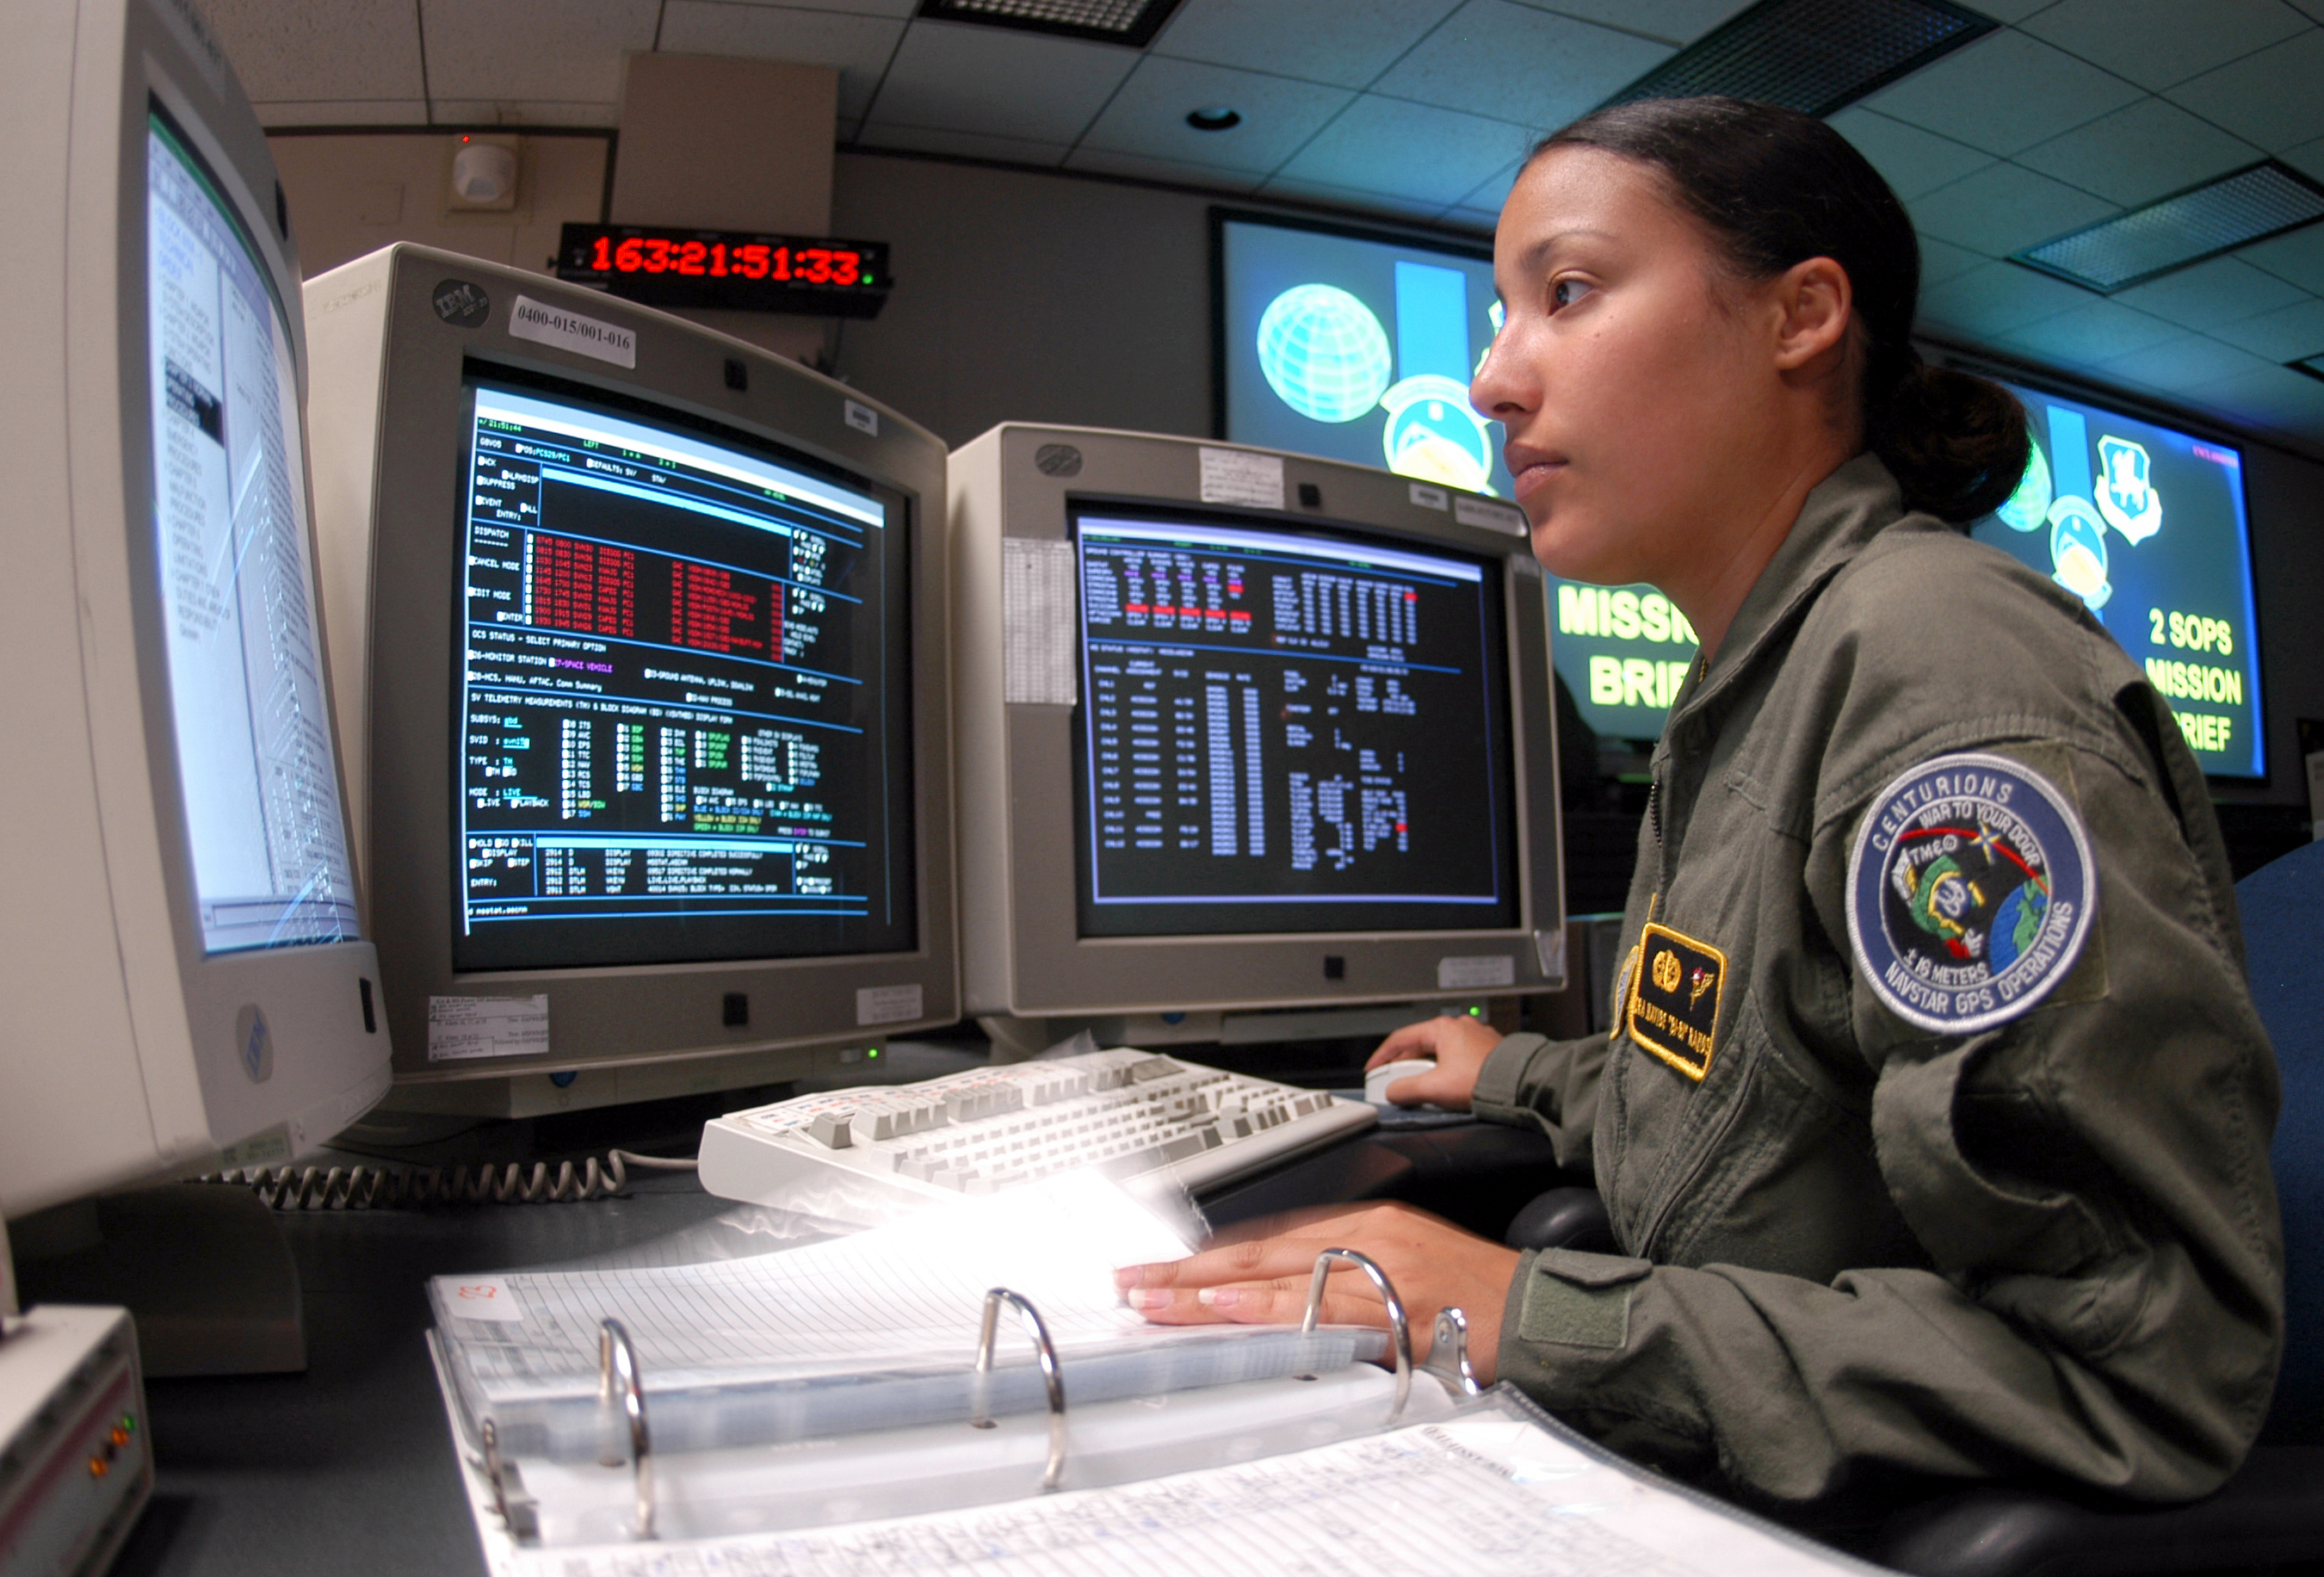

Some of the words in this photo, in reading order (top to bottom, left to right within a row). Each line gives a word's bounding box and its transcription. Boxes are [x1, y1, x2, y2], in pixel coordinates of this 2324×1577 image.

[591, 237, 859, 285] 163:21:51:33
[517, 305, 630, 349] 0400-015/001-016
[474, 526, 510, 538] DISPATCH
[502, 560, 520, 571] MODE
[493, 591, 511, 601] MODE
[473, 629, 486, 640] OCS
[489, 631, 516, 642] STATUS
[526, 635, 550, 646] SELECT
[553, 638, 580, 650] PRIMARY
[583, 642, 606, 652] OPTION
[2148, 607, 2166, 645] 2
[2168, 610, 2234, 656] SOPS
[518, 655, 547, 665] STATION
[586, 663, 613, 673] VEHICLE
[575, 680, 603, 693] Summary
[2145, 658, 2242, 705] MISSION
[485, 694, 522, 704] TELEMETRY
[525, 696, 572, 708] MEASUREMENTS
[600, 702, 619, 713] BLOCK
[470, 714, 501, 725] SUBSYS:
[469, 735, 488, 745] SVID
[469, 757, 487, 765] TYPE
[468, 788, 488, 796] MODE
[503, 788, 522, 796] LIVE
[1872, 774, 2012, 852] CENTURIONS
[1919, 801, 1950, 829] WAR
[1952, 801, 1972, 819] TO
[1976, 803, 2010, 833] YOUR
[2008, 825, 2041, 866] DOOR
[1885, 962, 1949, 1014] NAVSTAR
[1956, 992, 1994, 1015] GPS
[1998, 901, 2073, 1000] OPERATIONS
[1932, 962, 1989, 985] METERS
